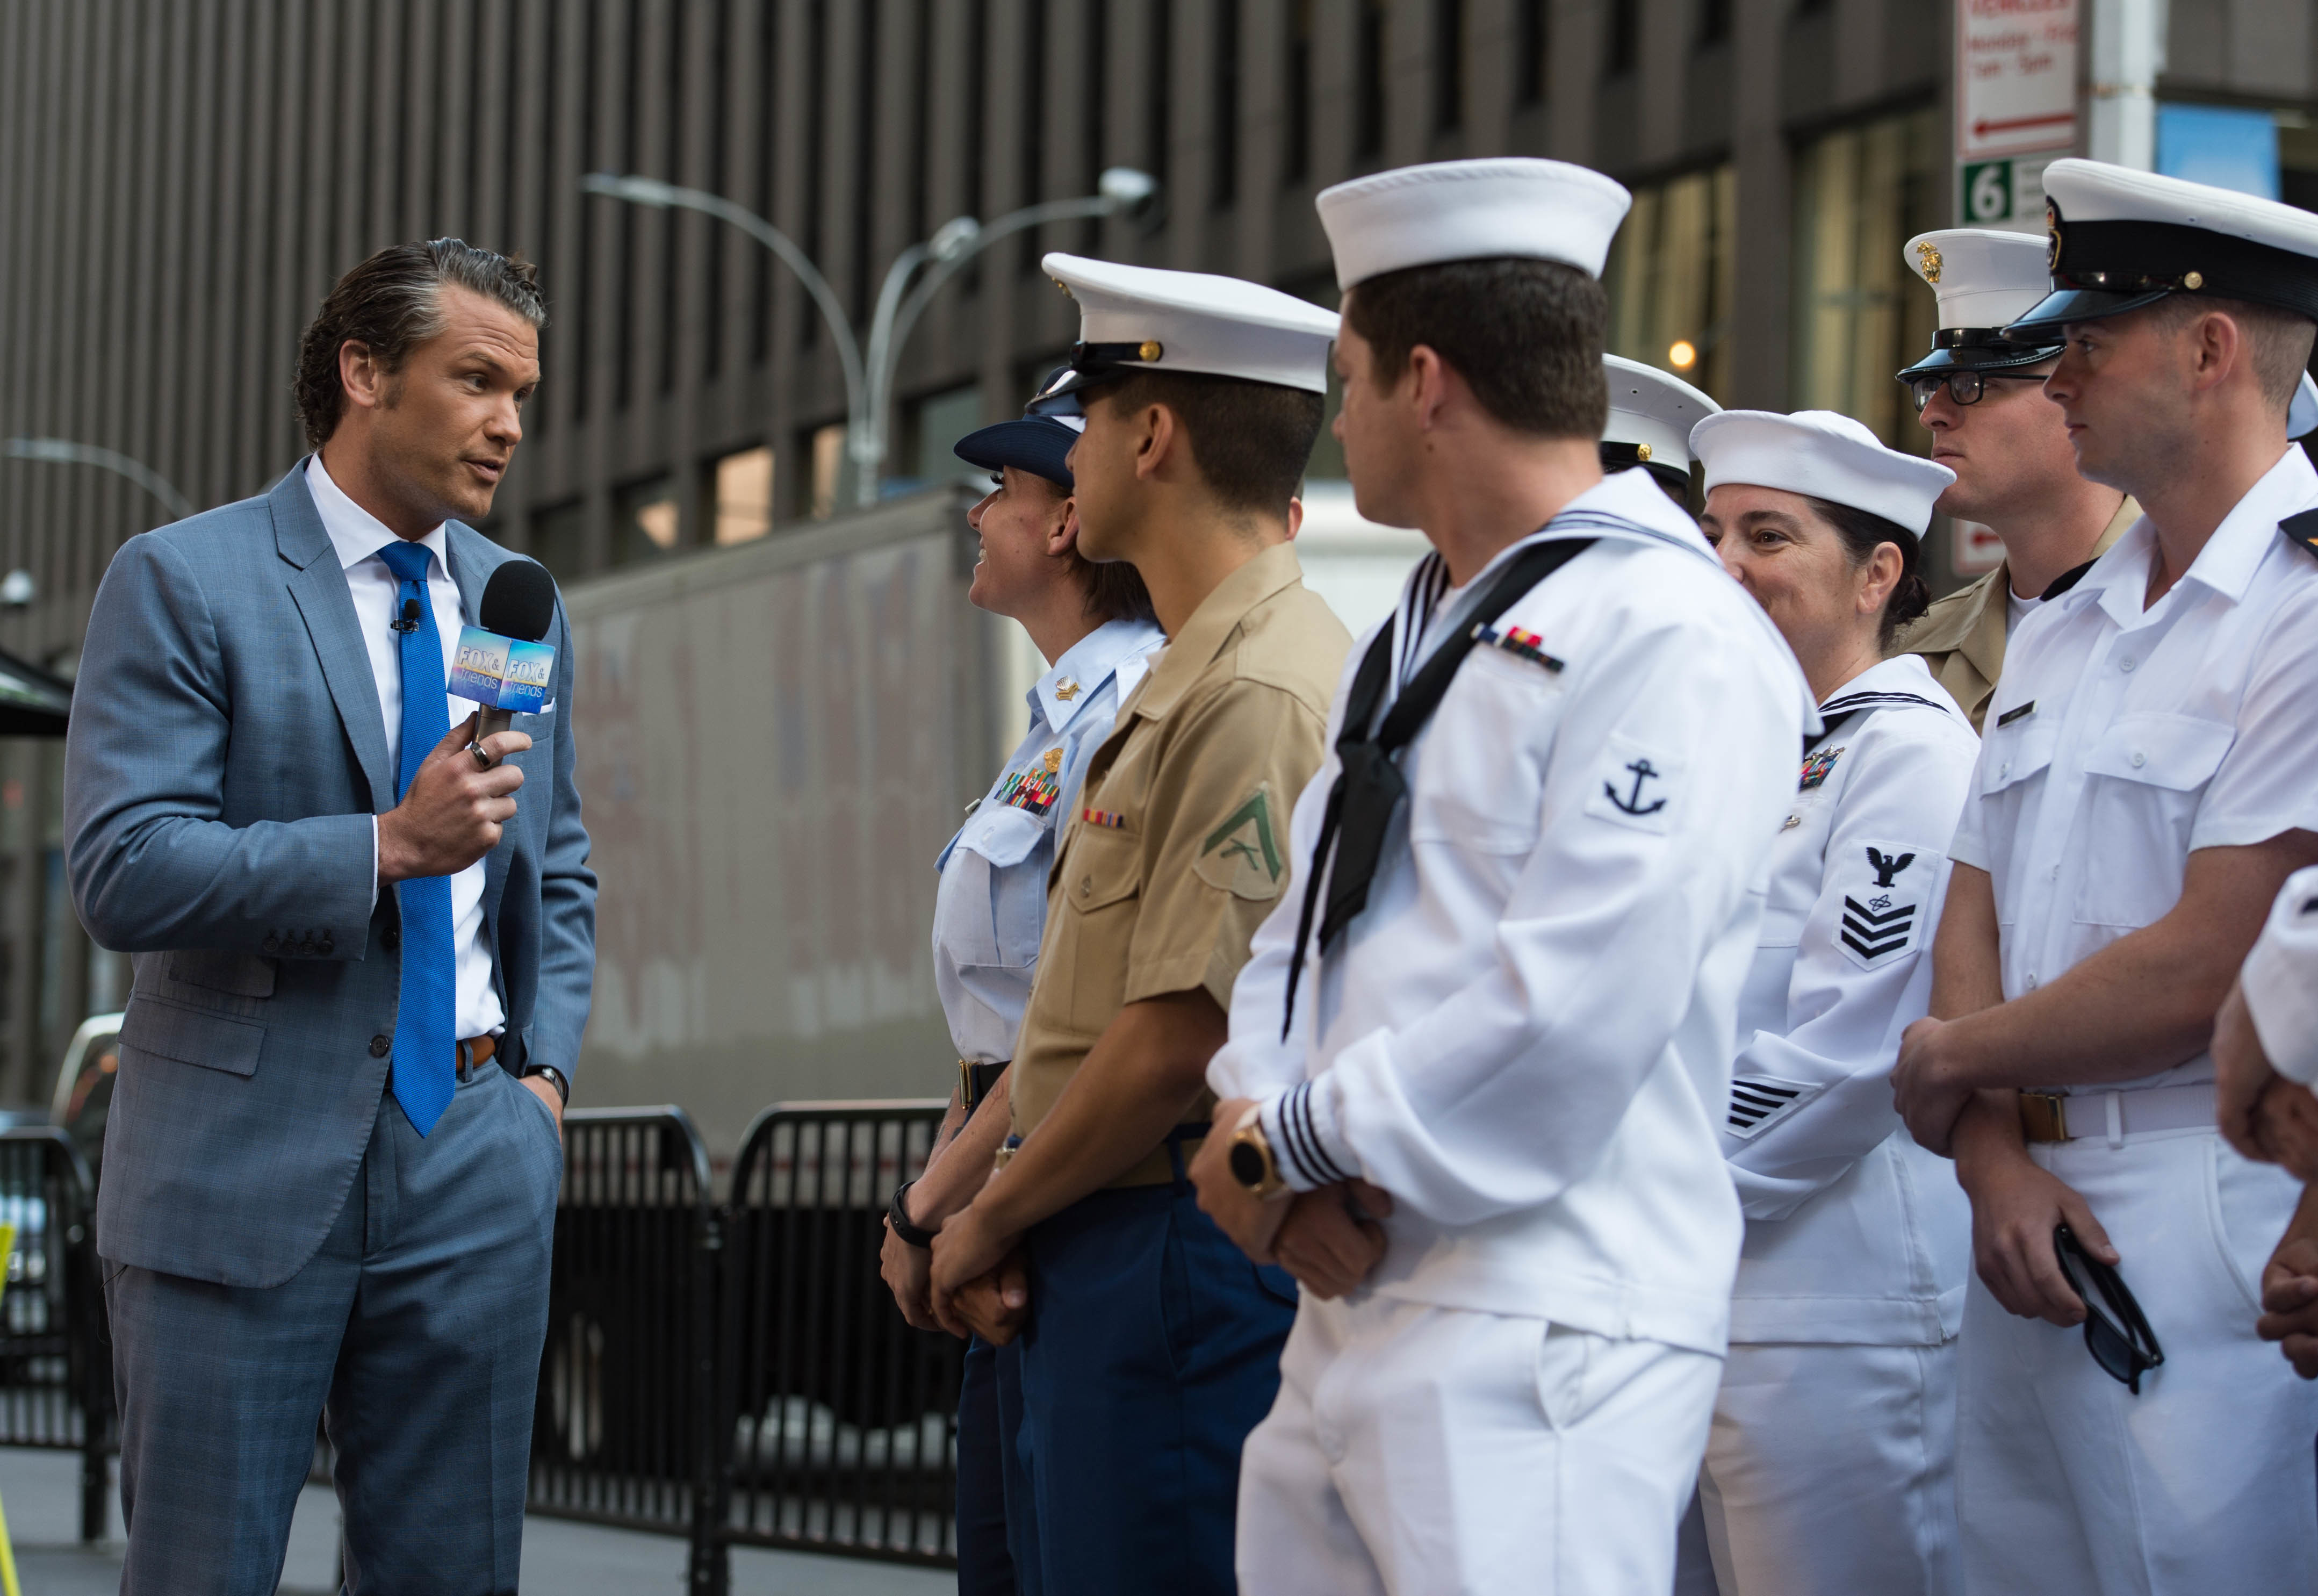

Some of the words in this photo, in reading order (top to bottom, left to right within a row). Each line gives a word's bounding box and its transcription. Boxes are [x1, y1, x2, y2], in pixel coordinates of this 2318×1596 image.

[1971, 165, 2005, 218] 6
[460, 667, 498, 689] friends
[509, 680, 543, 698] friends
